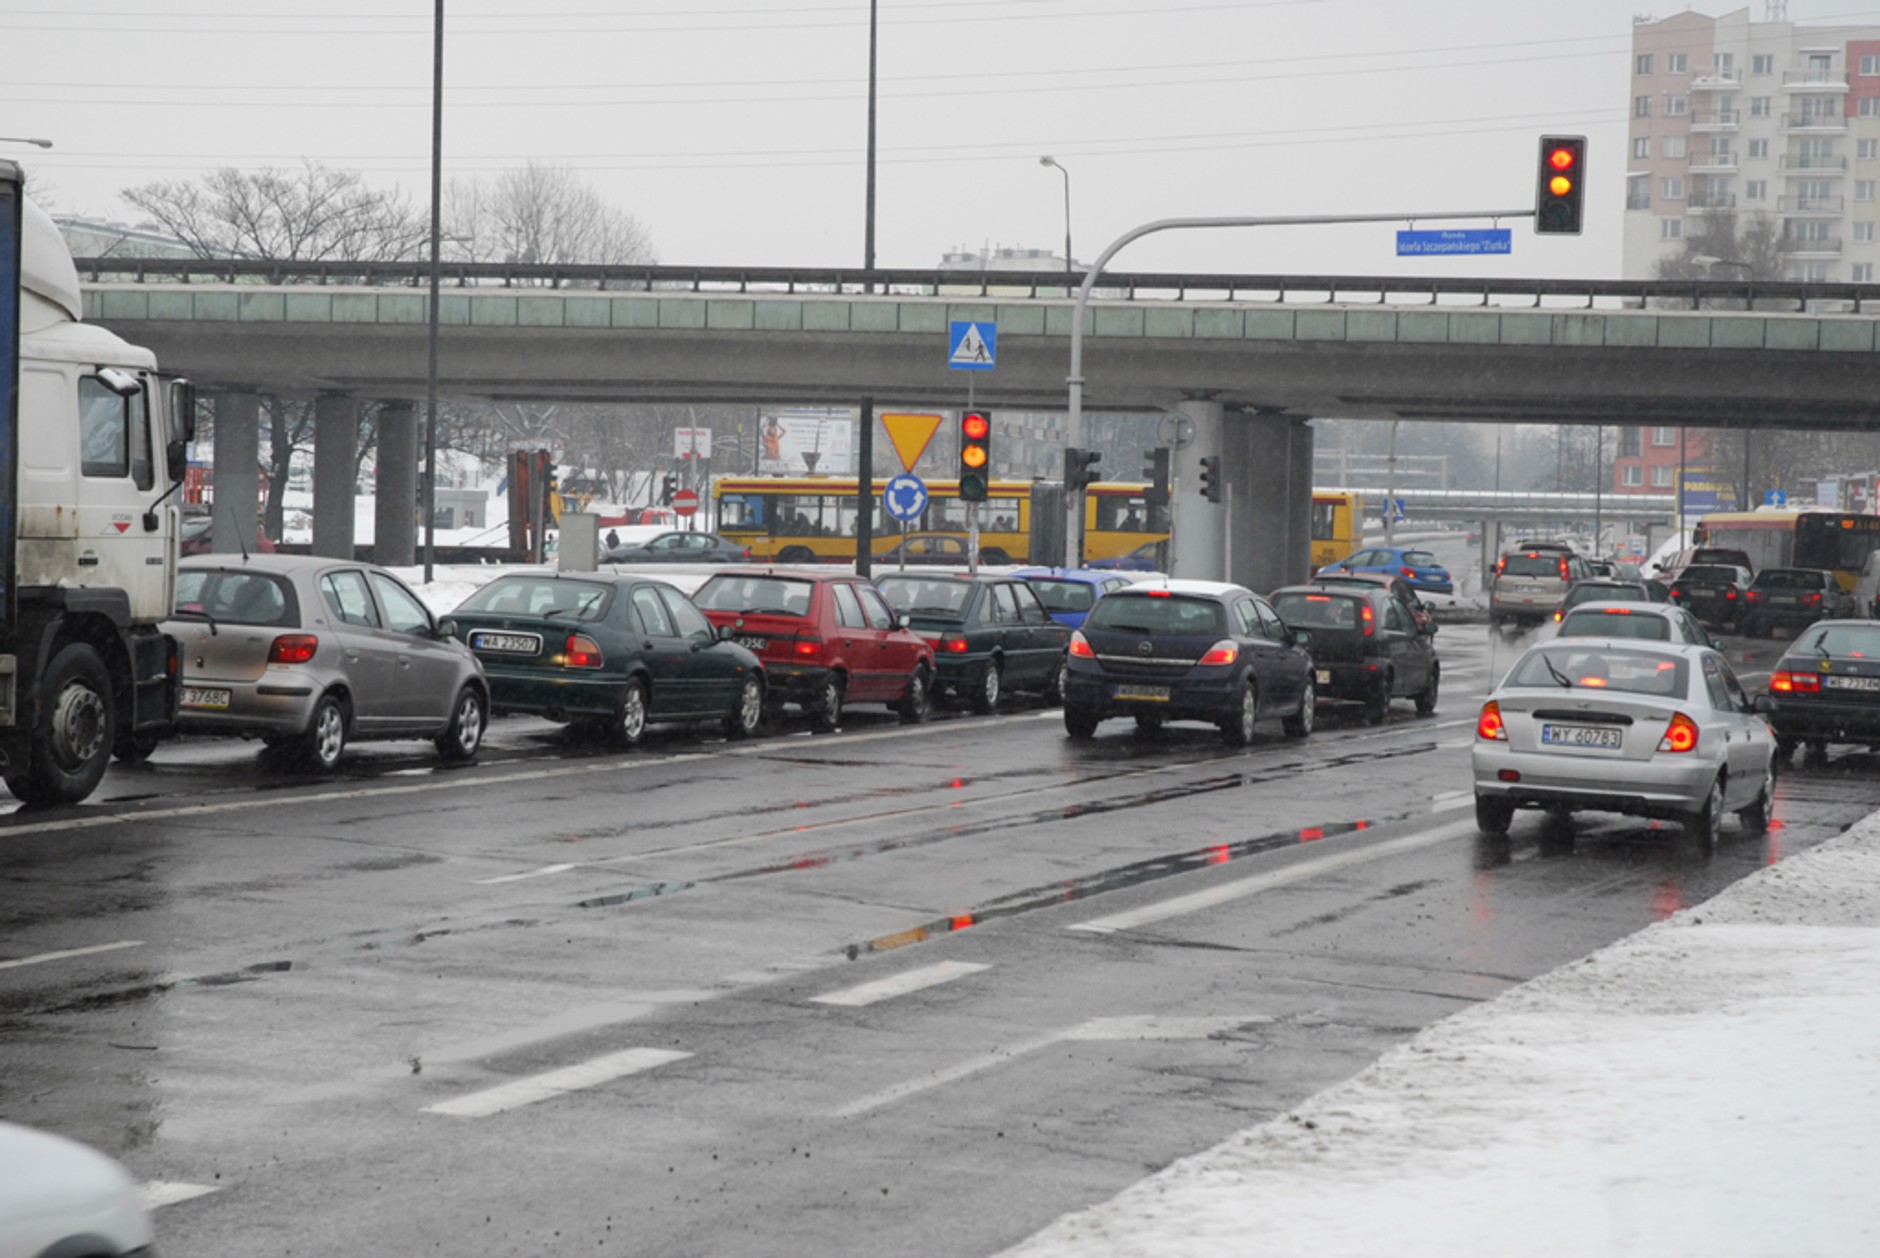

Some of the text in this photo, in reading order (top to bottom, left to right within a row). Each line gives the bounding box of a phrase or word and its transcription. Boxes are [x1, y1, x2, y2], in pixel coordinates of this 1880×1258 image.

[482, 634, 537, 650] WA 23507
[190, 689, 228, 705] 3768C
[1552, 727, 1620, 745] WY 60783
